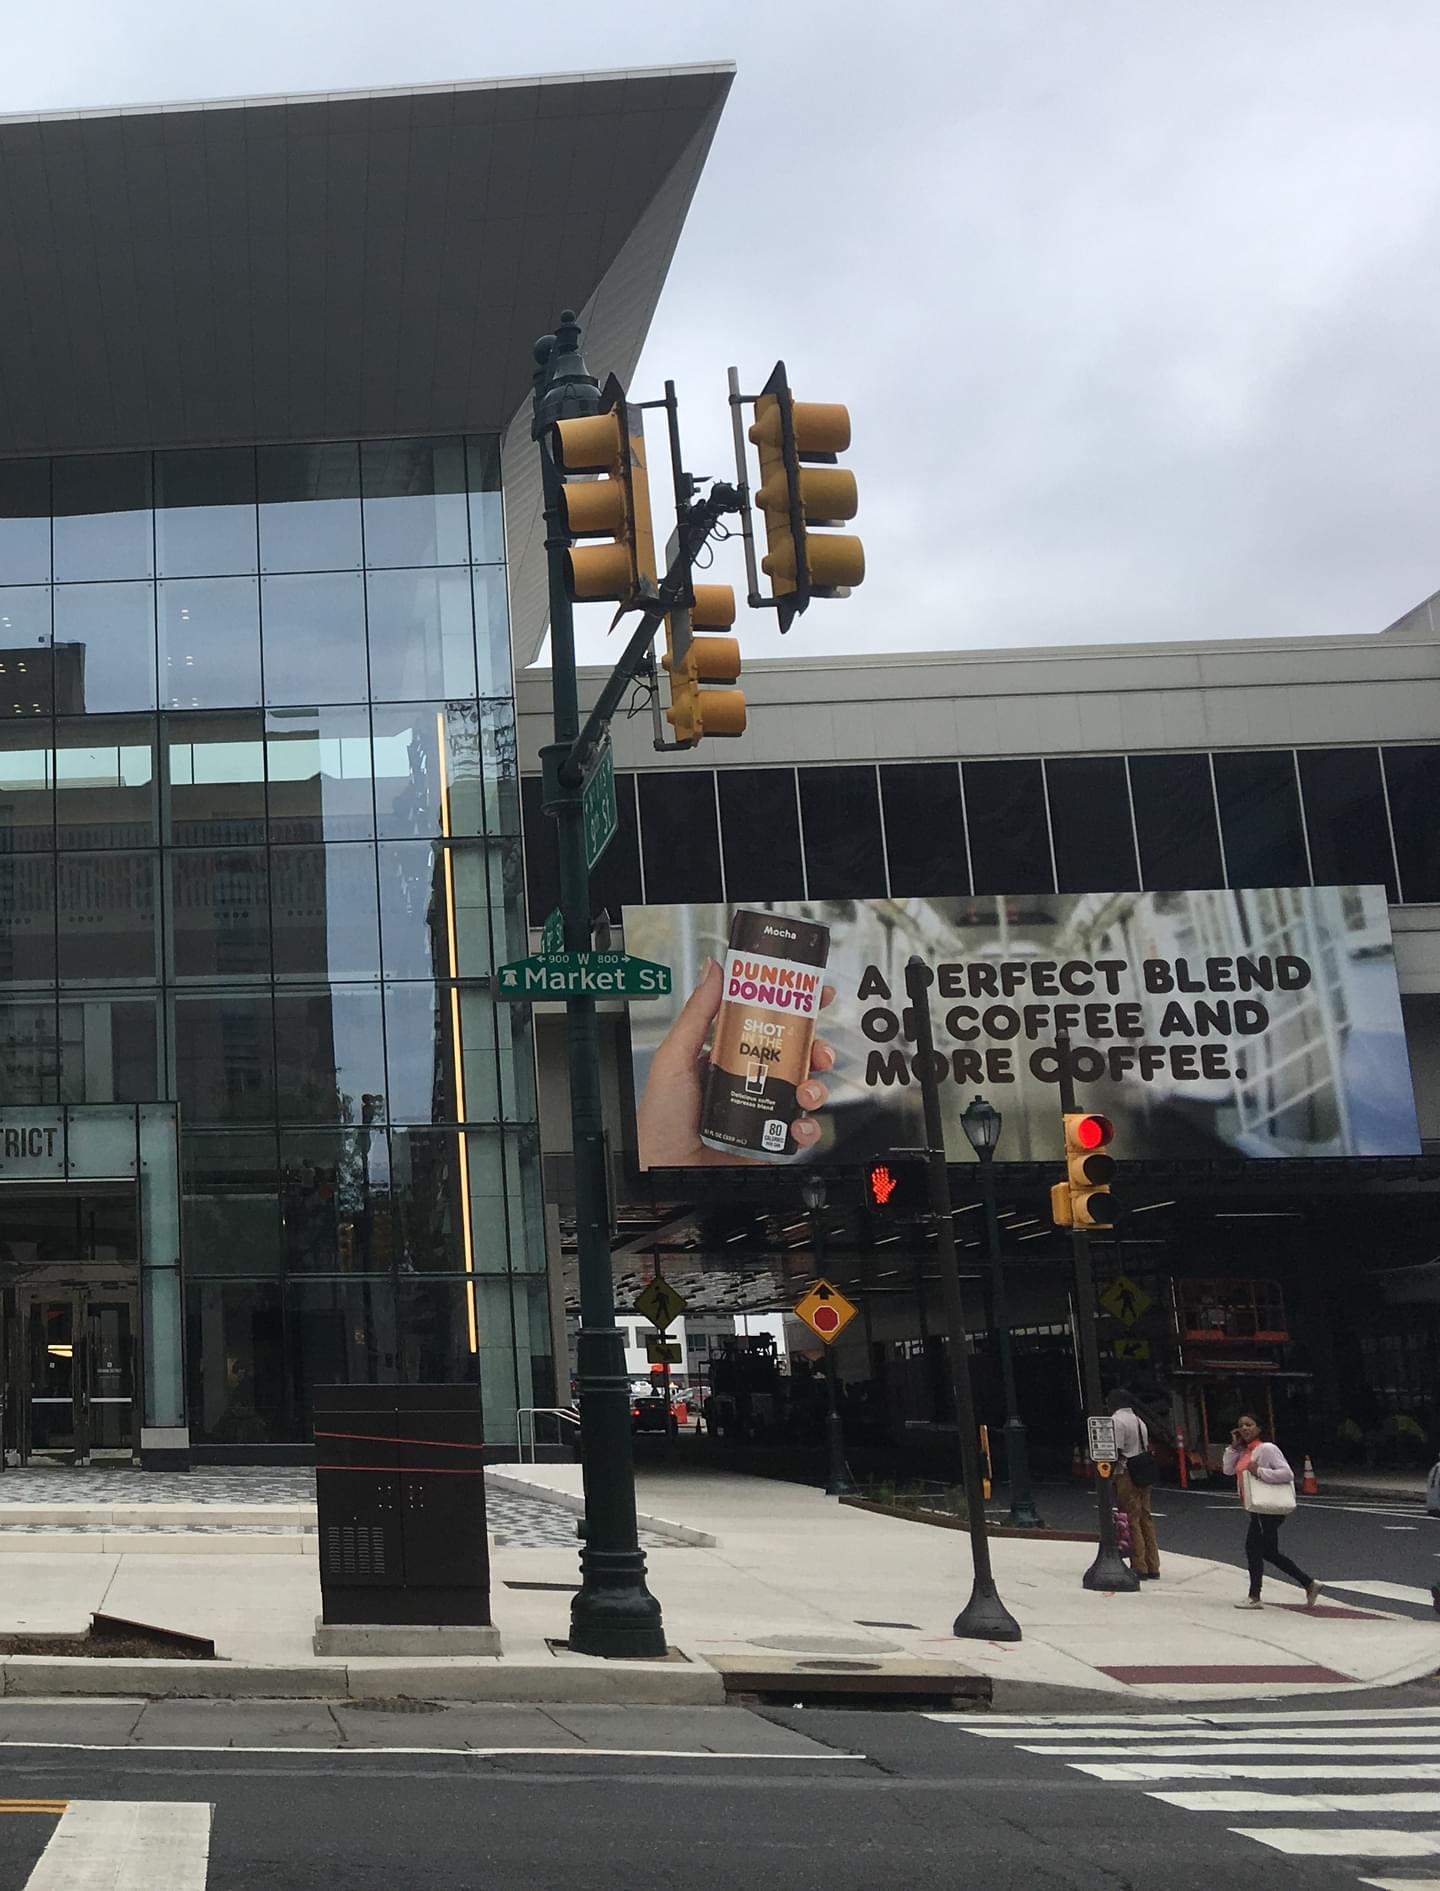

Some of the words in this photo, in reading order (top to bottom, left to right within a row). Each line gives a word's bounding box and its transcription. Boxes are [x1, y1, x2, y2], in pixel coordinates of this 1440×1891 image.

[763, 925, 797, 940] Mocha
[548, 954, 570, 964] 900
[577, 953, 590, 965] W
[597, 954, 619, 964] 800
[525, 967, 626, 990] Market
[639, 969, 667, 990] St
[732, 959, 819, 993] DUNKIN'
[857, 965, 891, 1000] A
[1143, 955, 1311, 994] BLEND
[728, 978, 813, 1013] DONUTS
[743, 1018, 786, 1038] SHOT
[945, 1003, 1144, 1042] COFFEE
[1160, 1000, 1269, 1038] AND
[741, 1031, 755, 1044] IN
[758, 1034, 784, 1049] THE
[740, 1042, 781, 1063] DARK
[1029, 1044, 1247, 1083] COFFEE.
[769, 1123, 782, 1137] 80
